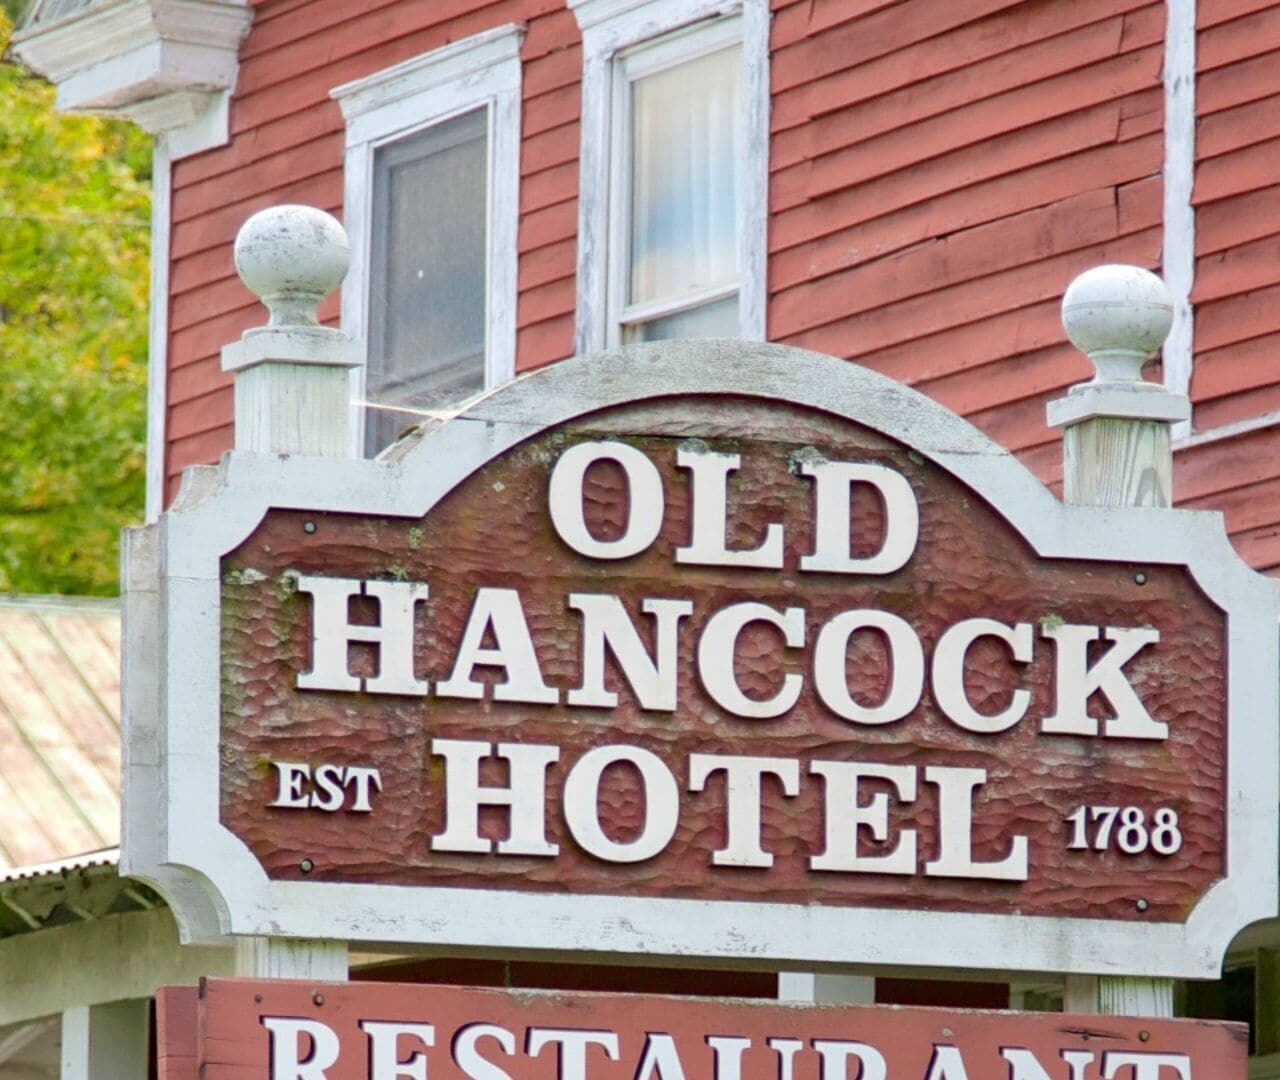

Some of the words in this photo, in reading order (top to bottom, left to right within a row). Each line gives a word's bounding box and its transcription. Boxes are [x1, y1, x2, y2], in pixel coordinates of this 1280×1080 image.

[548, 441, 920, 573] OLD
[294, 574, 1169, 740] HANCOCK
[272, 761, 383, 812] EST
[431, 738, 1029, 881] HOTEL
[1067, 805, 1183, 855] 1788
